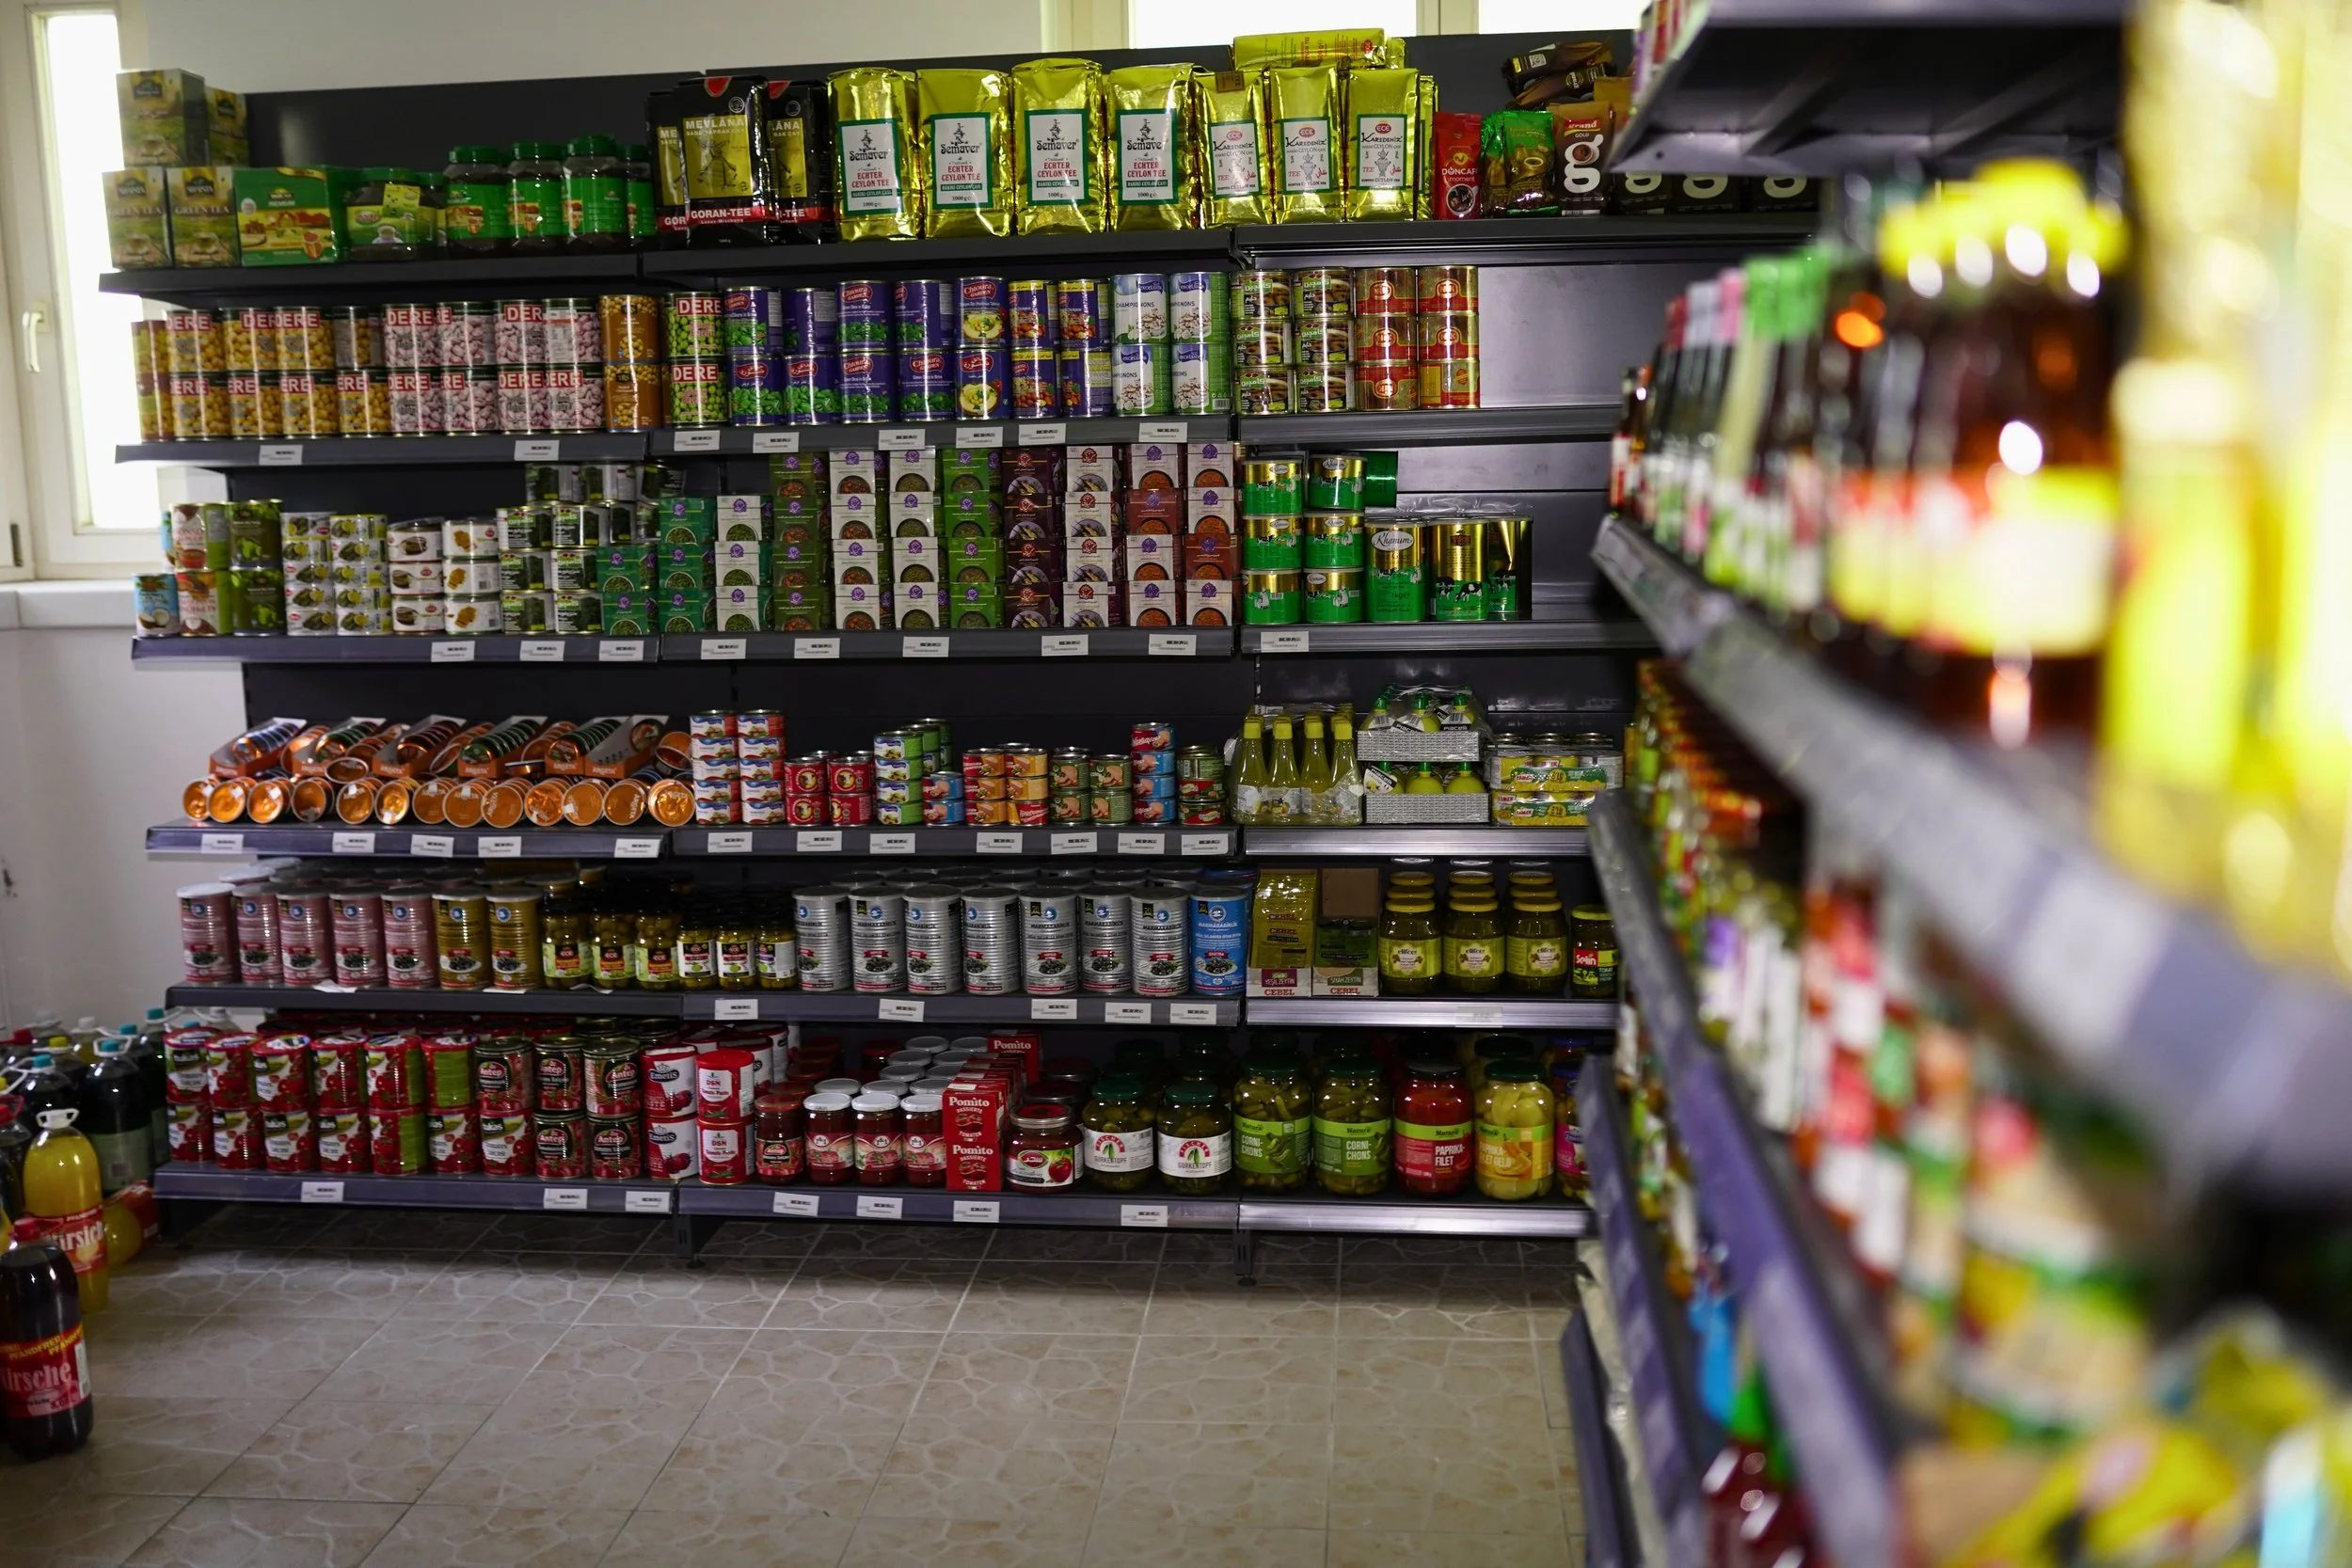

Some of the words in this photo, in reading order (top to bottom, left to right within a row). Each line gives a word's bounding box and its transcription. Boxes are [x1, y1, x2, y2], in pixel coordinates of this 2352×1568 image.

[941, 143, 980, 154] Semaver
[1037, 140, 1077, 150] Semaver
[1127, 140, 1166, 150] Semave
[850, 150, 888, 161] Semaver
[857, 171, 882, 180] ECHTER
[942, 173, 966, 182] CEYLON
[851, 180, 876, 188] CEYLON
[691, 208, 752, 218] GORAN-TEE
[678, 300, 722, 314] DERE
[388, 309, 433, 325] DERE
[673, 367, 716, 380] DERE
[1374, 531, 1413, 546] Khanum
[1576, 953, 1597, 965] Selin
[1242, 1135, 1263, 1148] CORNI-
[1346, 1140, 1371, 1150] CORNI-
[1242, 1144, 1263, 1158] CHONS
[1346, 1150, 1371, 1161] CHONS
[1435, 1144, 1465, 1156] PAPRIKA-
[1435, 1156, 1454, 1166] FILET
[2, 1361, 72, 1392] irsche
